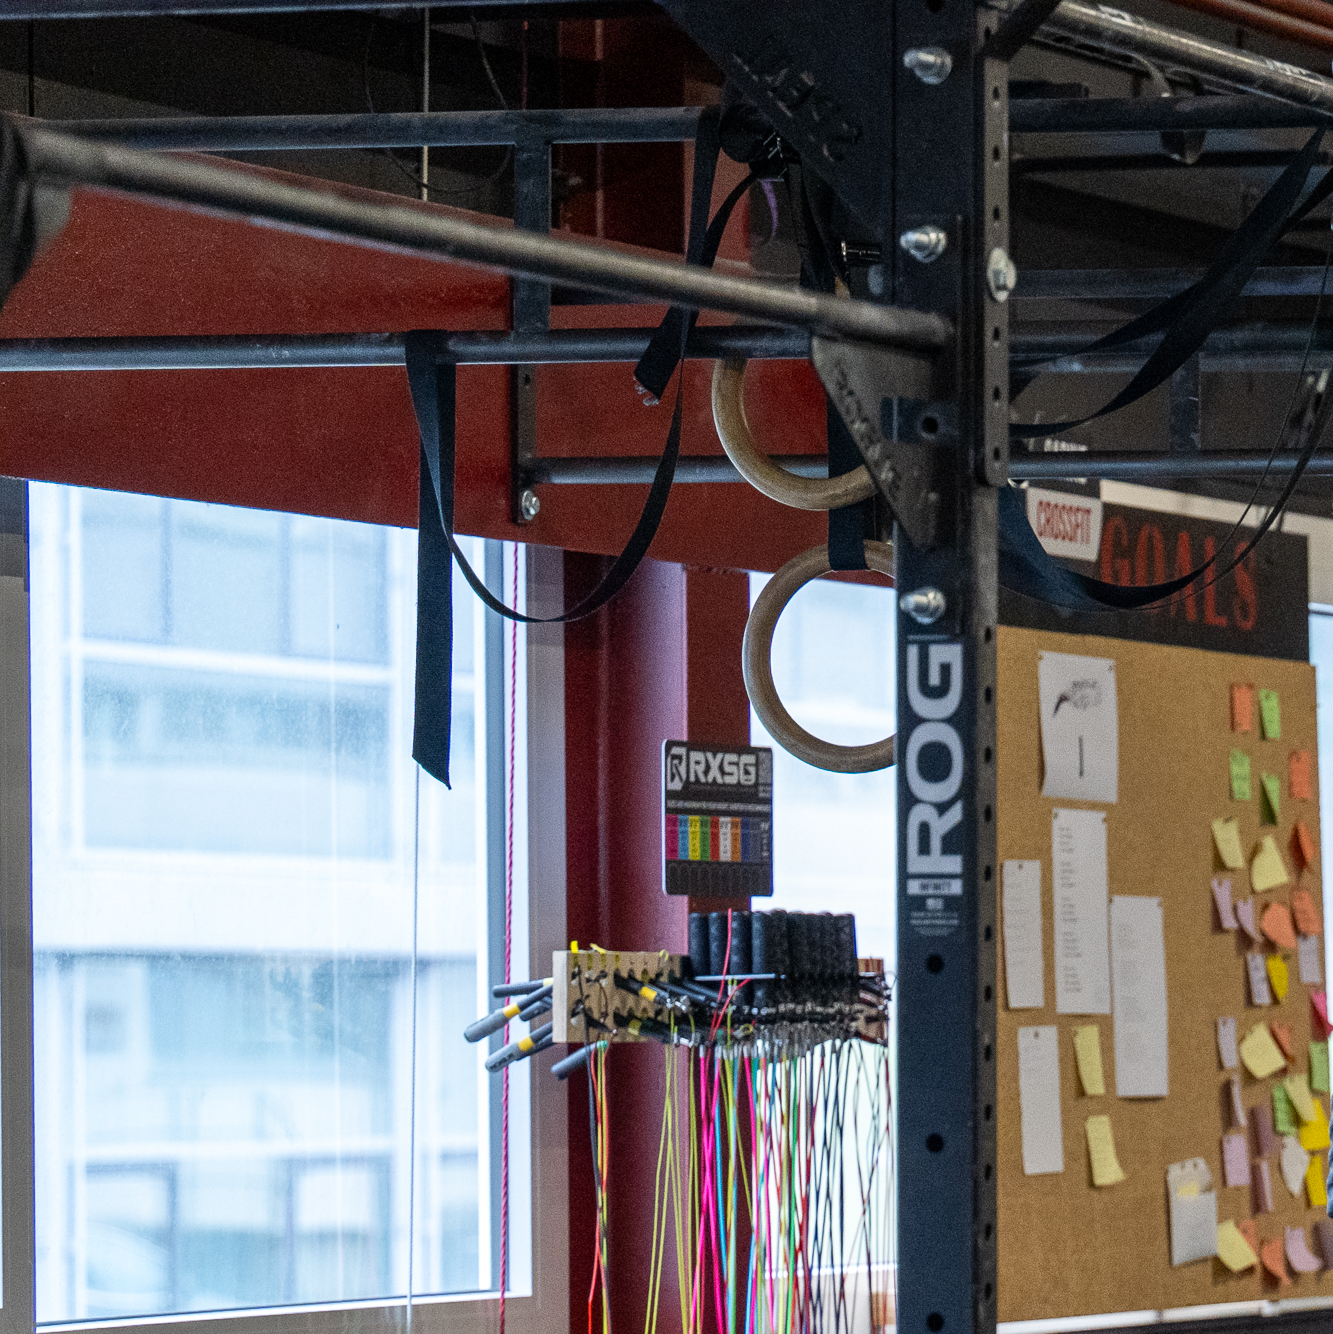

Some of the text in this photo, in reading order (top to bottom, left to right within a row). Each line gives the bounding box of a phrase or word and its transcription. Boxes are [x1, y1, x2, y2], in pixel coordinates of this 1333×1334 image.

[1101, 517, 1257, 630] GOALS
[689, 751, 757, 786] RXSG
[906, 643, 963, 874] ROG
